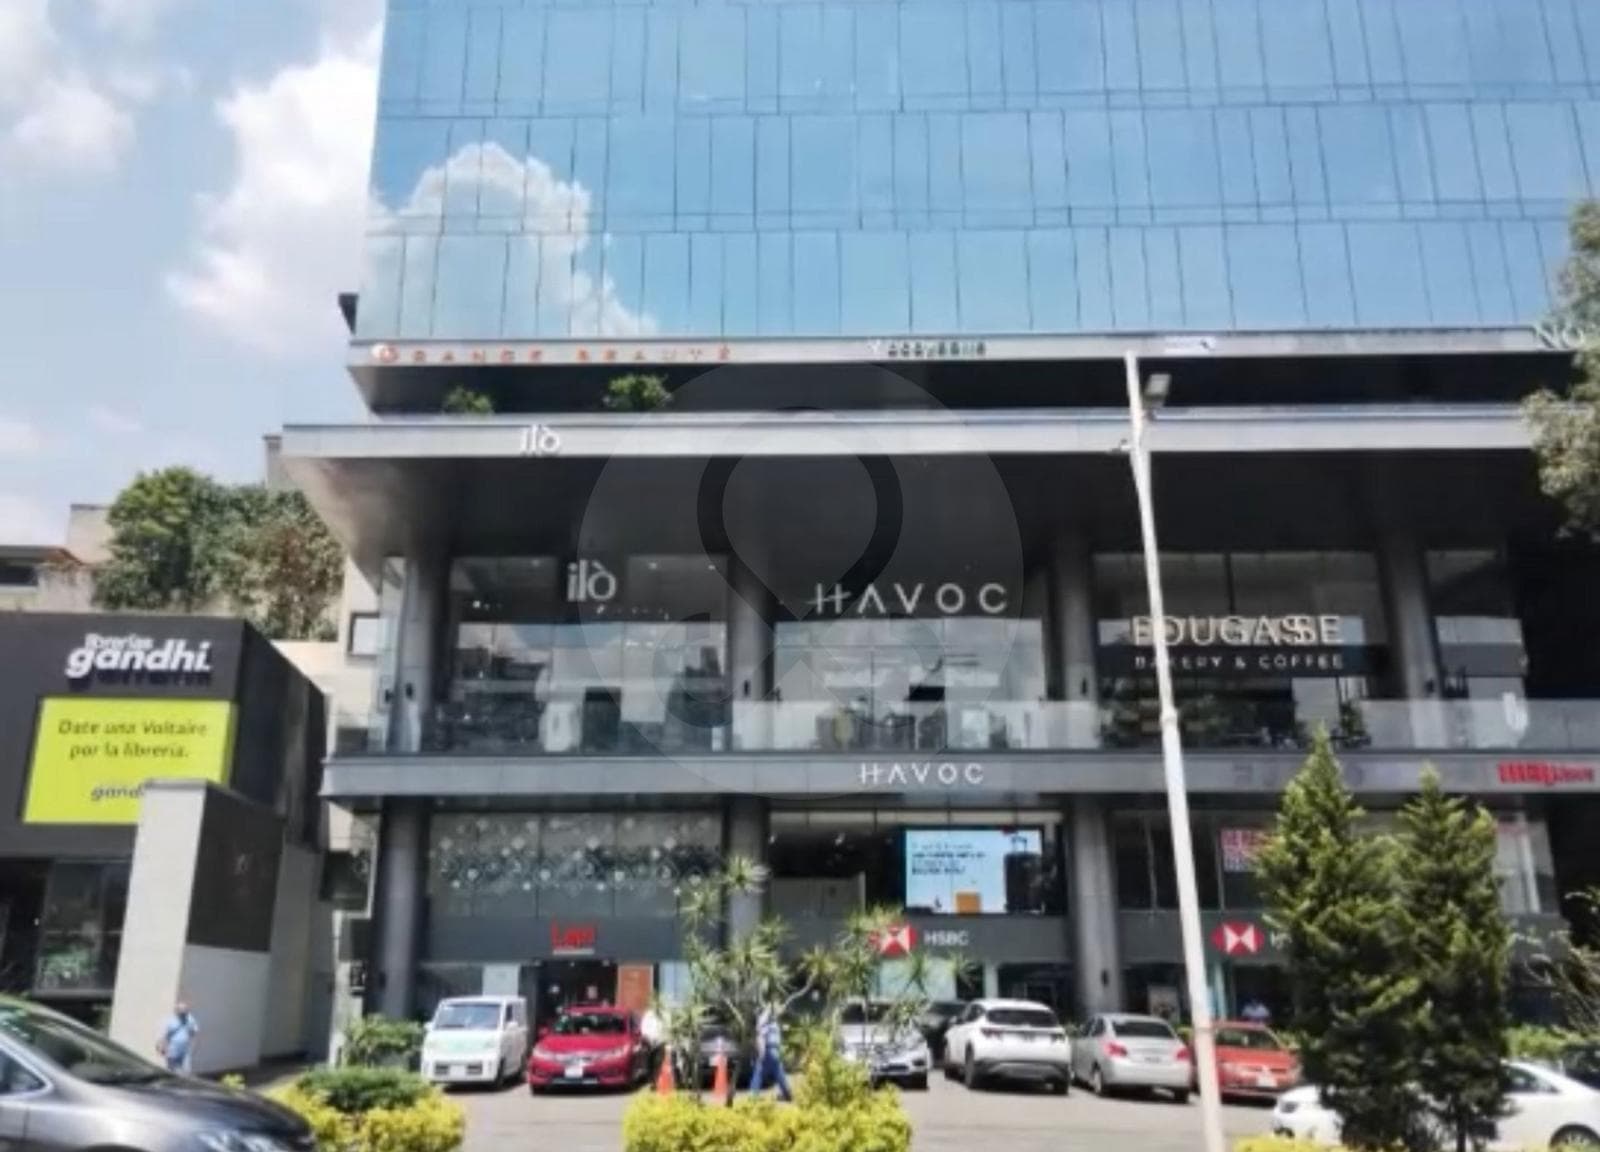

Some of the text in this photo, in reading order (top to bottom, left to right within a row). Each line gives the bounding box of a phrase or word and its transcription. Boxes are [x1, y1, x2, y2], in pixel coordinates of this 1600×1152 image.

[567, 560, 617, 602] ilò
[815, 582, 1008, 614] HAVOC
[1257, 653, 1344, 670] COFFEE
[859, 763, 984, 785] HAVOC
[91, 783, 144, 801] gand
[923, 929, 970, 947] HSBC
